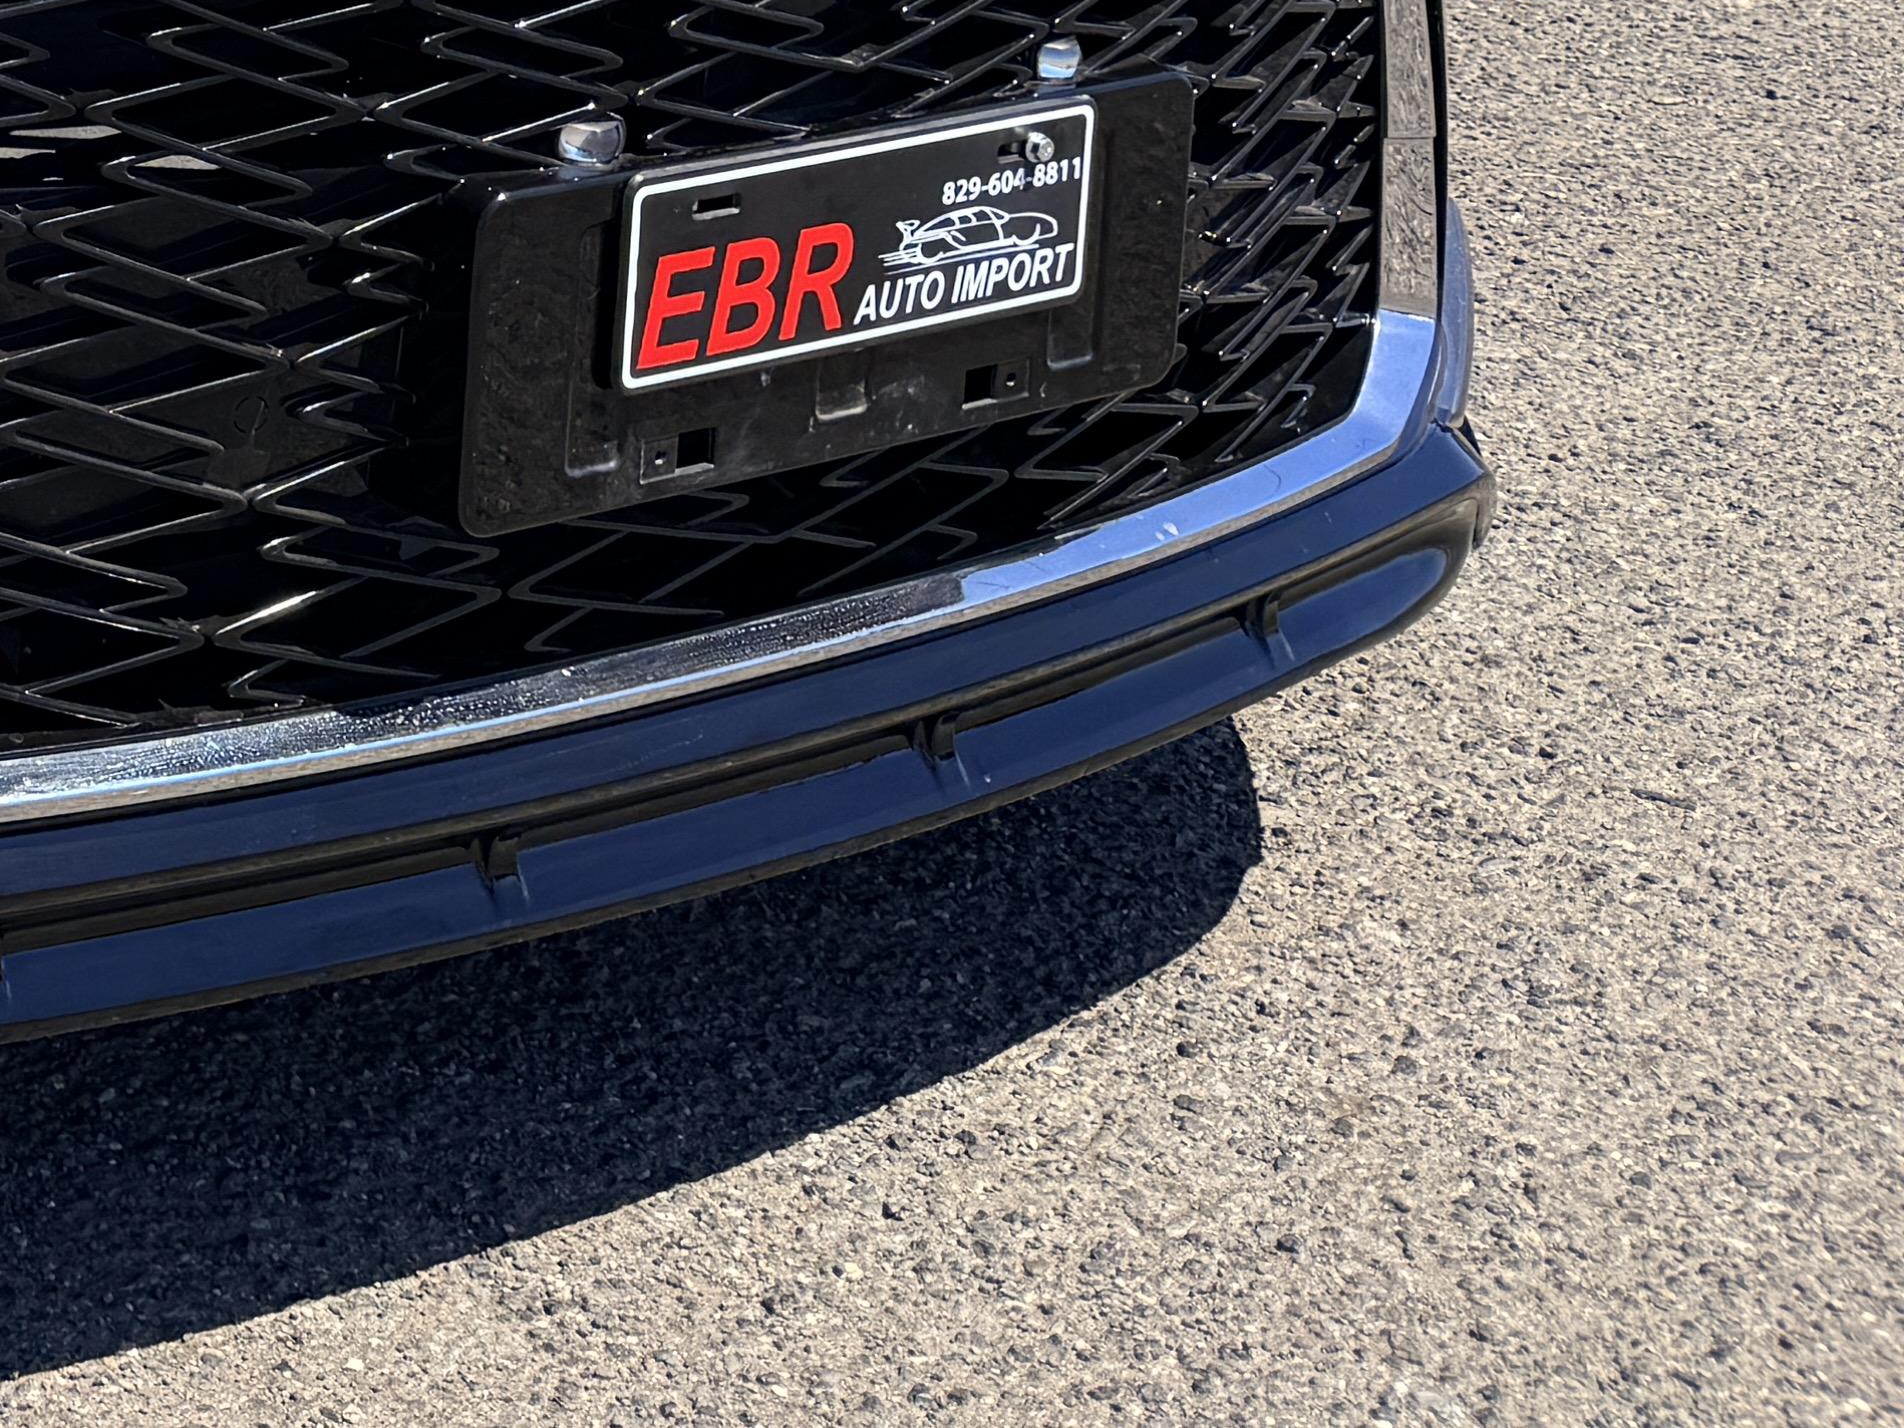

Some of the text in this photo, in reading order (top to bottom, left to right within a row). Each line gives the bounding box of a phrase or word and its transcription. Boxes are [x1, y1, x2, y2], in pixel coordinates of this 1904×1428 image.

[941, 157, 1083, 207] 829-604-8811
[636, 222, 854, 370] EBR
[853, 243, 1076, 326] AUTO IMPORT
